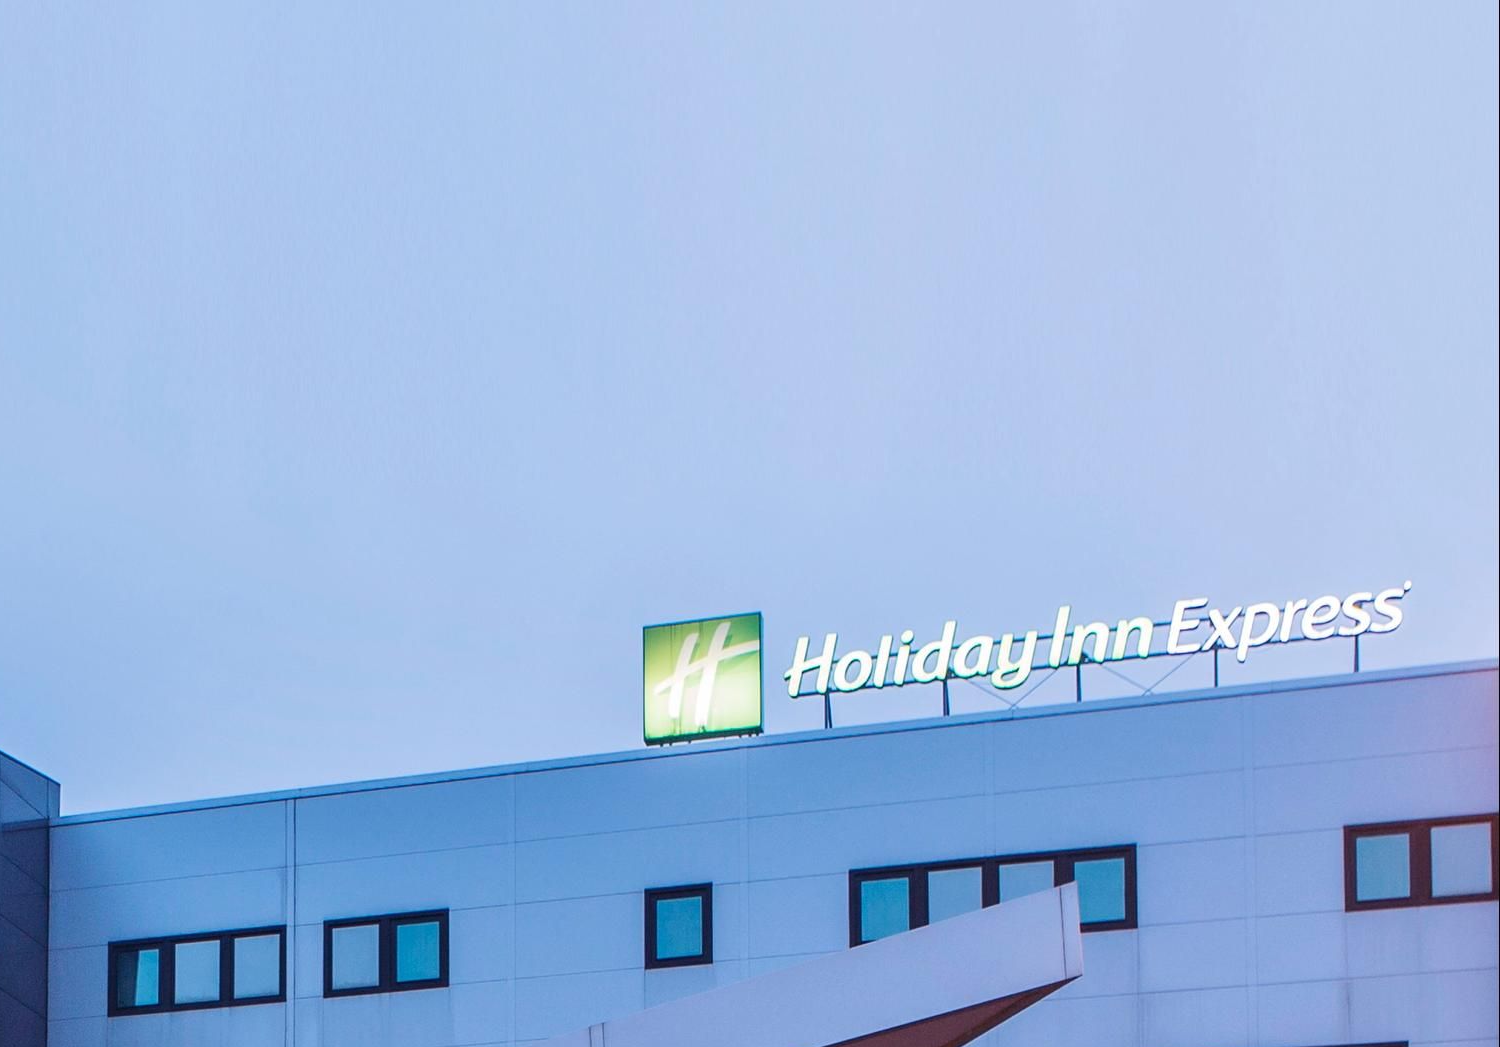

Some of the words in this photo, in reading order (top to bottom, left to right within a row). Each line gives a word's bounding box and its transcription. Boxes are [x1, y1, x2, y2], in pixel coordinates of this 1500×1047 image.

[784, 620, 1039, 698] Holiday
[1048, 604, 1154, 669] Inn
[1166, 586, 1405, 663] Express
